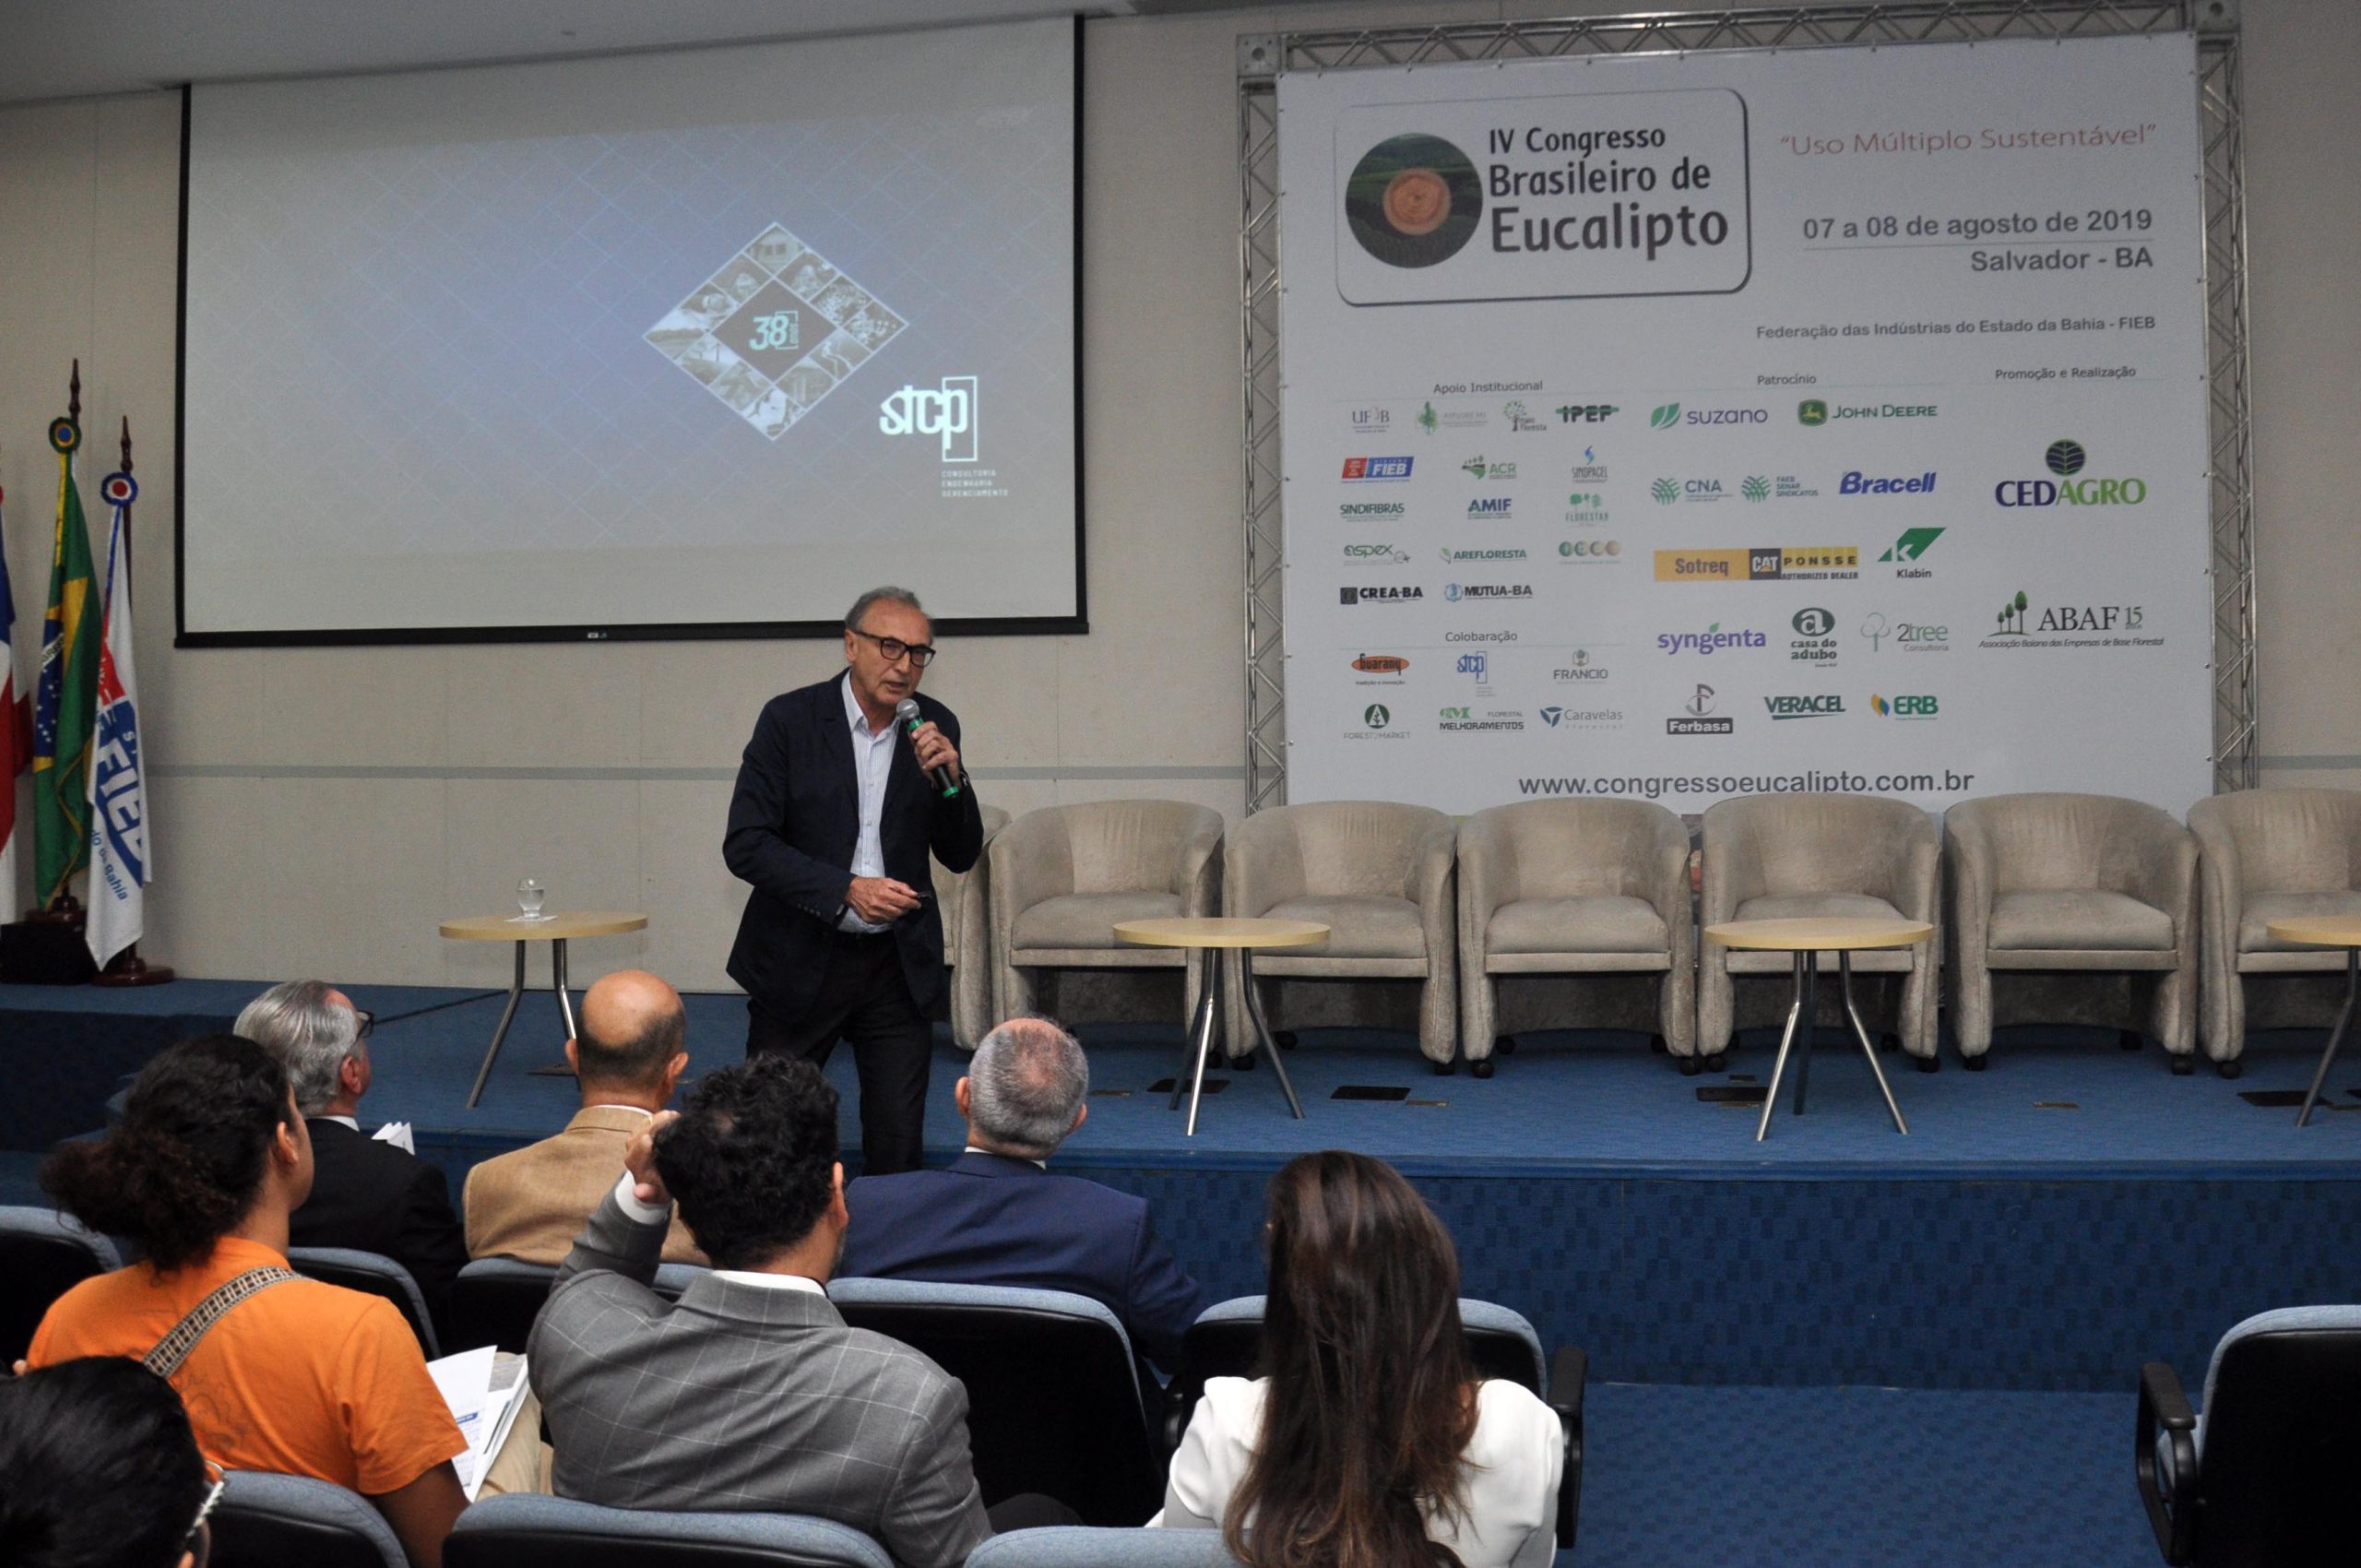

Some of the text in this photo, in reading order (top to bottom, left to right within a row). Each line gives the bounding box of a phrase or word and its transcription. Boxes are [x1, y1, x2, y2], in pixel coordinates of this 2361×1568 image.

[1489, 126, 1667, 158] IV Congresso
[1854, 129, 1972, 157] Múltiplo
[1489, 157, 1711, 196] Brasileiro de
[1491, 202, 1729, 261] Eucalipto
[1803, 209, 2153, 240] 07 a 08 de agosto de 2019
[1971, 249, 2091, 272] Salvador
[2116, 247, 2153, 268] BA
[749, 315, 789, 350] 38
[1756, 325, 1838, 340] Federação
[1842, 324, 1869, 337] das
[1874, 321, 1952, 335] Indústrias
[1955, 320, 1975, 333] do
[1979, 318, 2033, 333] Estado
[2036, 318, 2057, 331] da
[2061, 317, 2105, 331] Bahia
[2119, 316, 2155, 329] FIEB
[1757, 374, 1816, 386] Patrocínio
[1995, 367, 2056, 380] Promoção
[2071, 366, 2136, 379] Realização
[1433, 380, 1543, 396] Apoio Institucional
[879, 385, 968, 450] stcp
[1562, 404, 1614, 424] IPEF
[1687, 408, 1768, 425] suzano
[1372, 463, 1407, 476] FIEB
[1489, 462, 1516, 475] ACR
[1685, 480, 1723, 493] CNA
[1839, 471, 1937, 494] Bracell
[1995, 478, 2146, 507] CEDAGRO
[1467, 498, 1513, 513] AMIF
[1453, 549, 1527, 560] AREFLORESTA
[1783, 555, 1857, 566] PONSSE
[1675, 557, 1729, 576] Sotreq
[1752, 555, 1779, 573] CAT
[1896, 568, 1932, 579] Klabin
[1359, 587, 1424, 600] CREA-BA
[1465, 585, 1533, 598] MUTUA-BA
[2036, 606, 2119, 631] ABAF
[2124, 606, 2142, 624] 15
[1445, 630, 1518, 644] Colobaração
[1657, 628, 1766, 654] syngenta
[1897, 623, 1949, 643] 2tree
[1791, 638, 1837, 648] casa do
[1791, 649, 1837, 659] adubo
[1553, 669, 1608, 680] FRANCIO
[1764, 695, 1846, 714] VERACEL
[1893, 695, 1939, 715] ERB
[1564, 708, 1623, 720] Caravelas
[1439, 721, 1525, 731] MELHORAMENTOS
[1669, 720, 1730, 733] Ferbasa
[1519, 770, 1975, 799] www.congressoeucalipto.com.br
